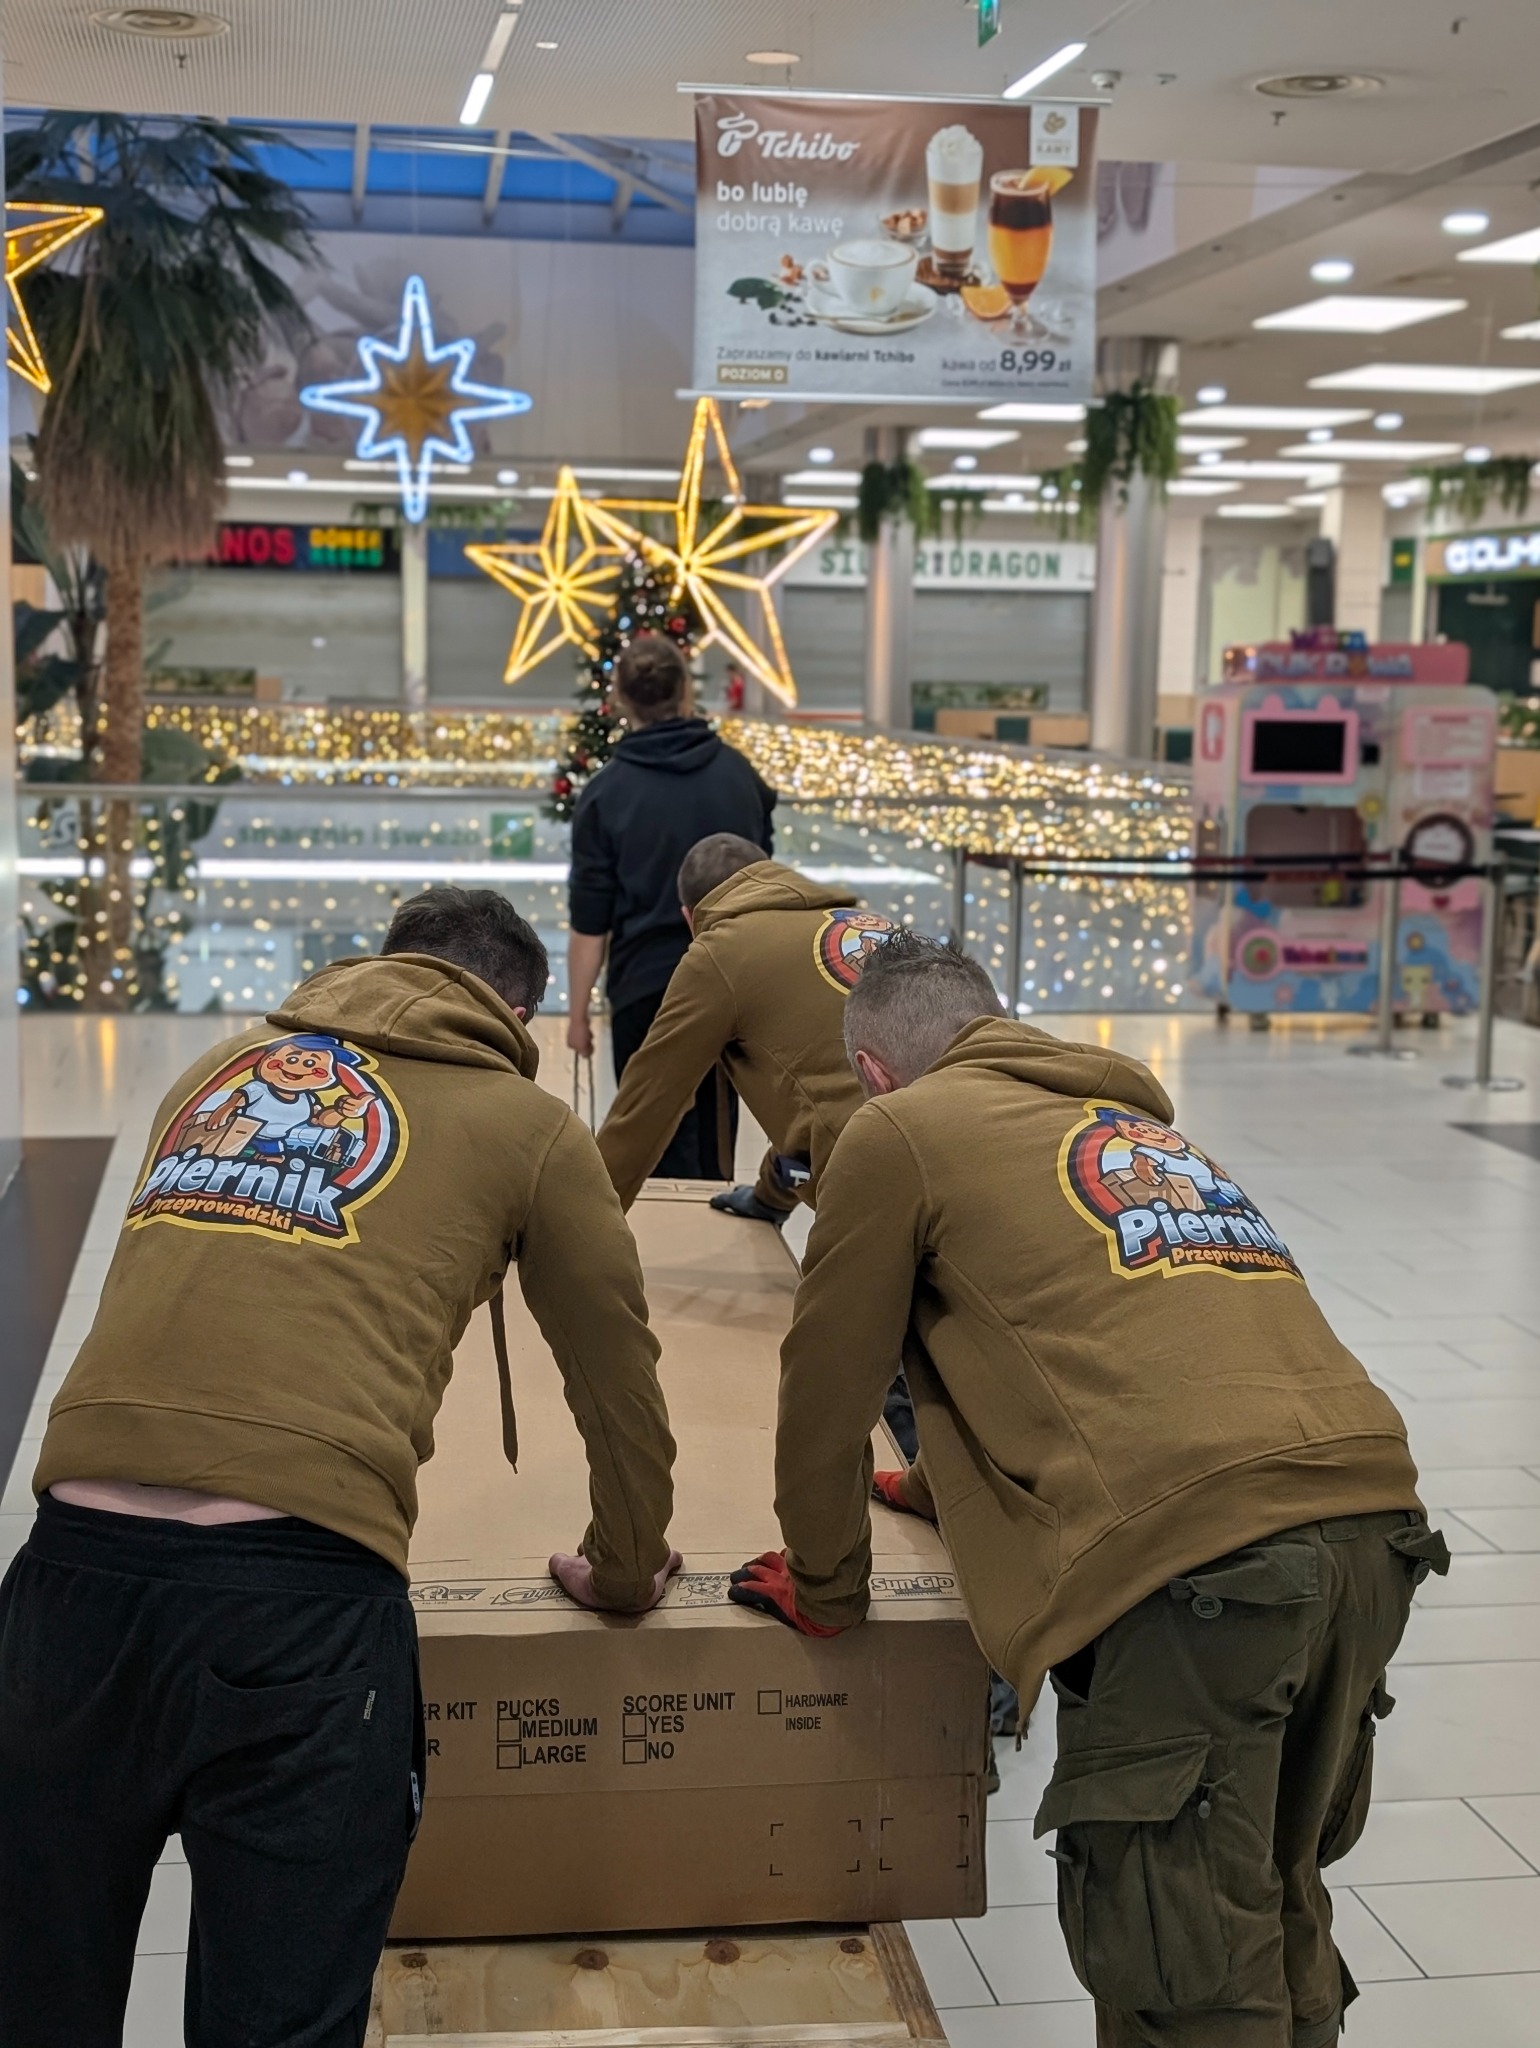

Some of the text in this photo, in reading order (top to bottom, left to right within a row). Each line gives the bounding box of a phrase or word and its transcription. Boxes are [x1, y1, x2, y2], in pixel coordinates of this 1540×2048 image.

[757, 130, 861, 161] Tchibo
[717, 180, 808, 209] bo lubię
[717, 211, 844, 239] dobrą kawę
[717, 346, 915, 364] Zapraszamy do kawiarni Tchibo
[1000, 349, 1056, 375] 8,99
[720, 367, 772, 381] POZIOM
[948, 551, 1061, 579] DRAGON
[1172, 1246, 1294, 1272] Przeprowadzk
[678, 1575, 730, 1583] TORNAD
[871, 1576, 954, 1591] Sun-Glo
[496, 1698, 560, 1719] PUCKS
[622, 1692, 736, 1713] SCORE UNIT
[785, 1693, 849, 1708] HARDWARE
[446, 1702, 478, 1721] KIT
[522, 1718, 598, 1738] MEDIUM
[648, 1715, 685, 1733] YES
[785, 1717, 822, 1731] INSIDE
[522, 1745, 587, 1765] LARGE
[648, 1741, 675, 1760] NO
